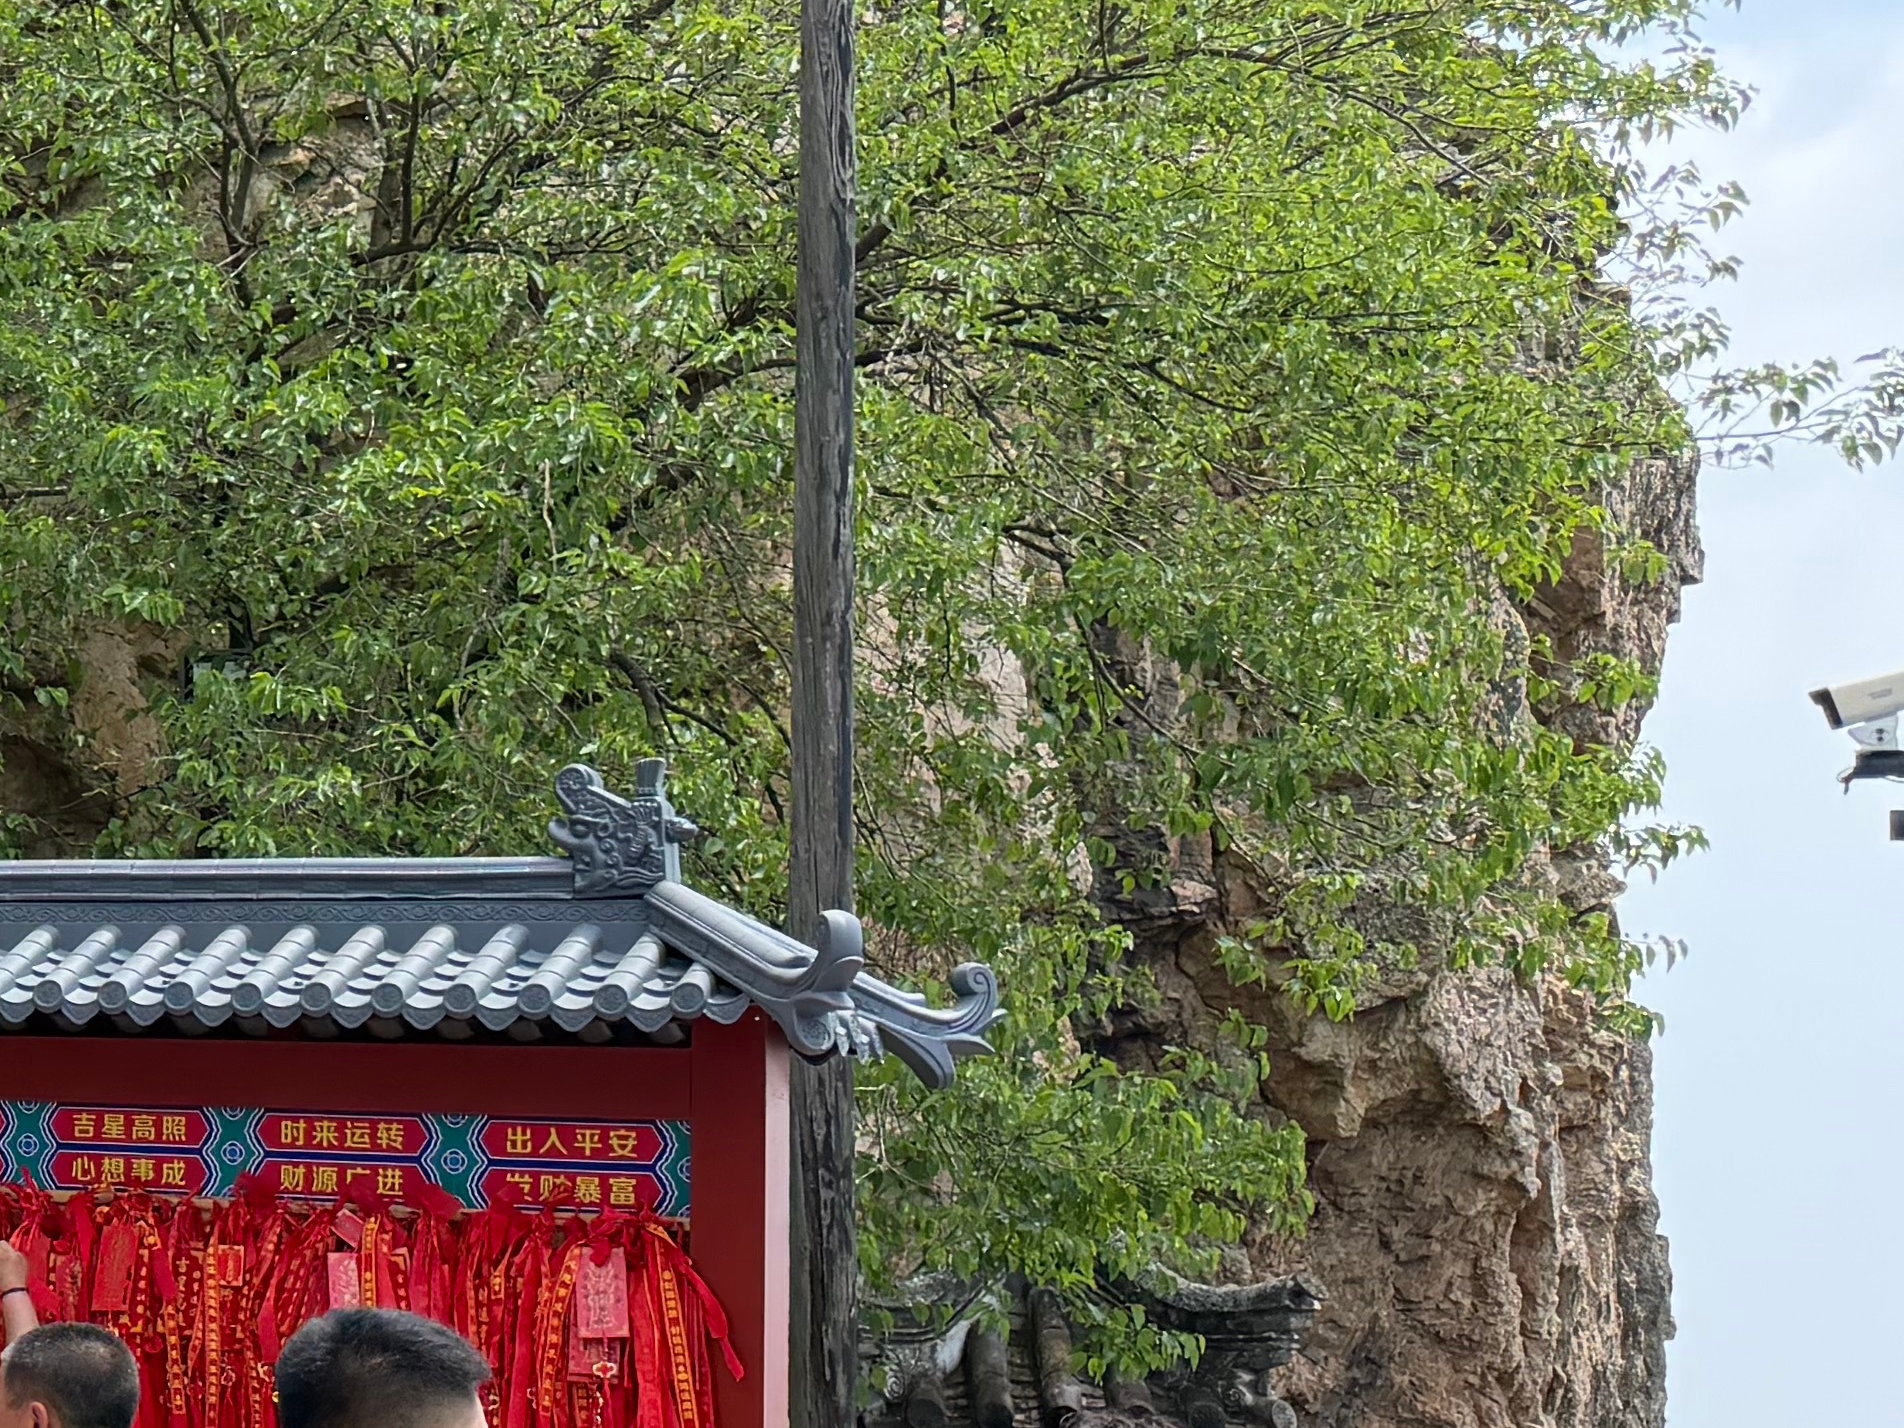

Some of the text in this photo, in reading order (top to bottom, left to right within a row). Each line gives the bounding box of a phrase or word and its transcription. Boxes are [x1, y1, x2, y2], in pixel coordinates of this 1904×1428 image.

[72, 1112, 187, 1142] 吉星高照
[279, 1119, 405, 1150] 时来运转
[505, 1125, 638, 1159] 出入平安
[71, 1155, 187, 1186] 心想事成
